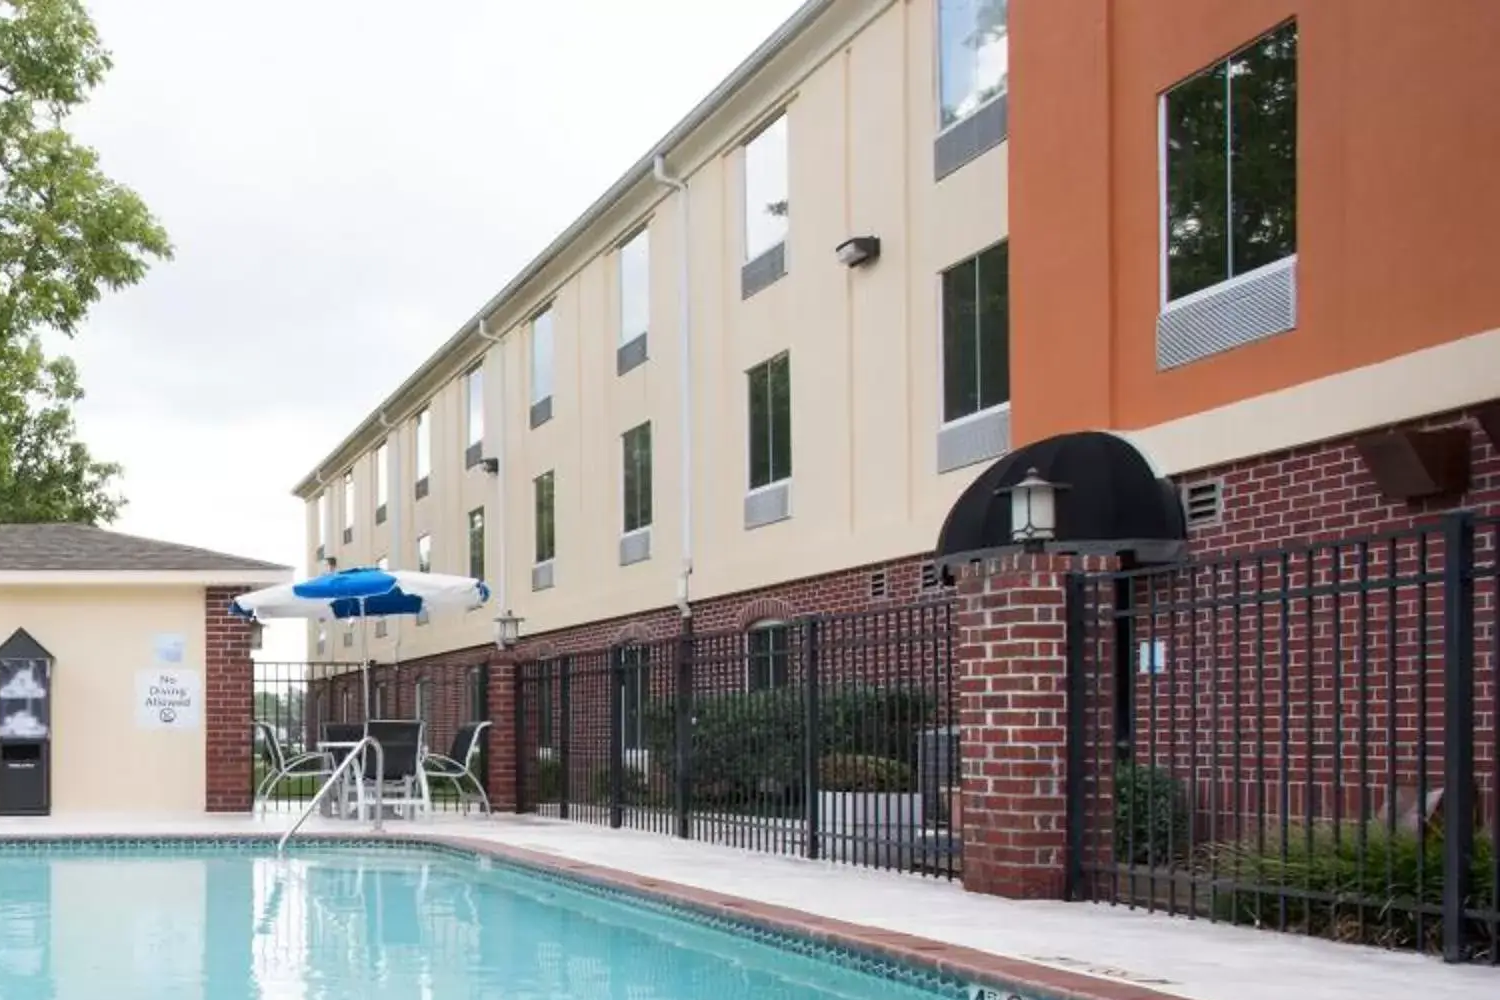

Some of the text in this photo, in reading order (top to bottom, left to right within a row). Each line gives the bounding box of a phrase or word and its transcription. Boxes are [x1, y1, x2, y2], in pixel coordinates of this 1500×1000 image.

[159, 675, 177, 685] No
[149, 686, 187, 699] Diving
[145, 698, 191, 708] Allowed
